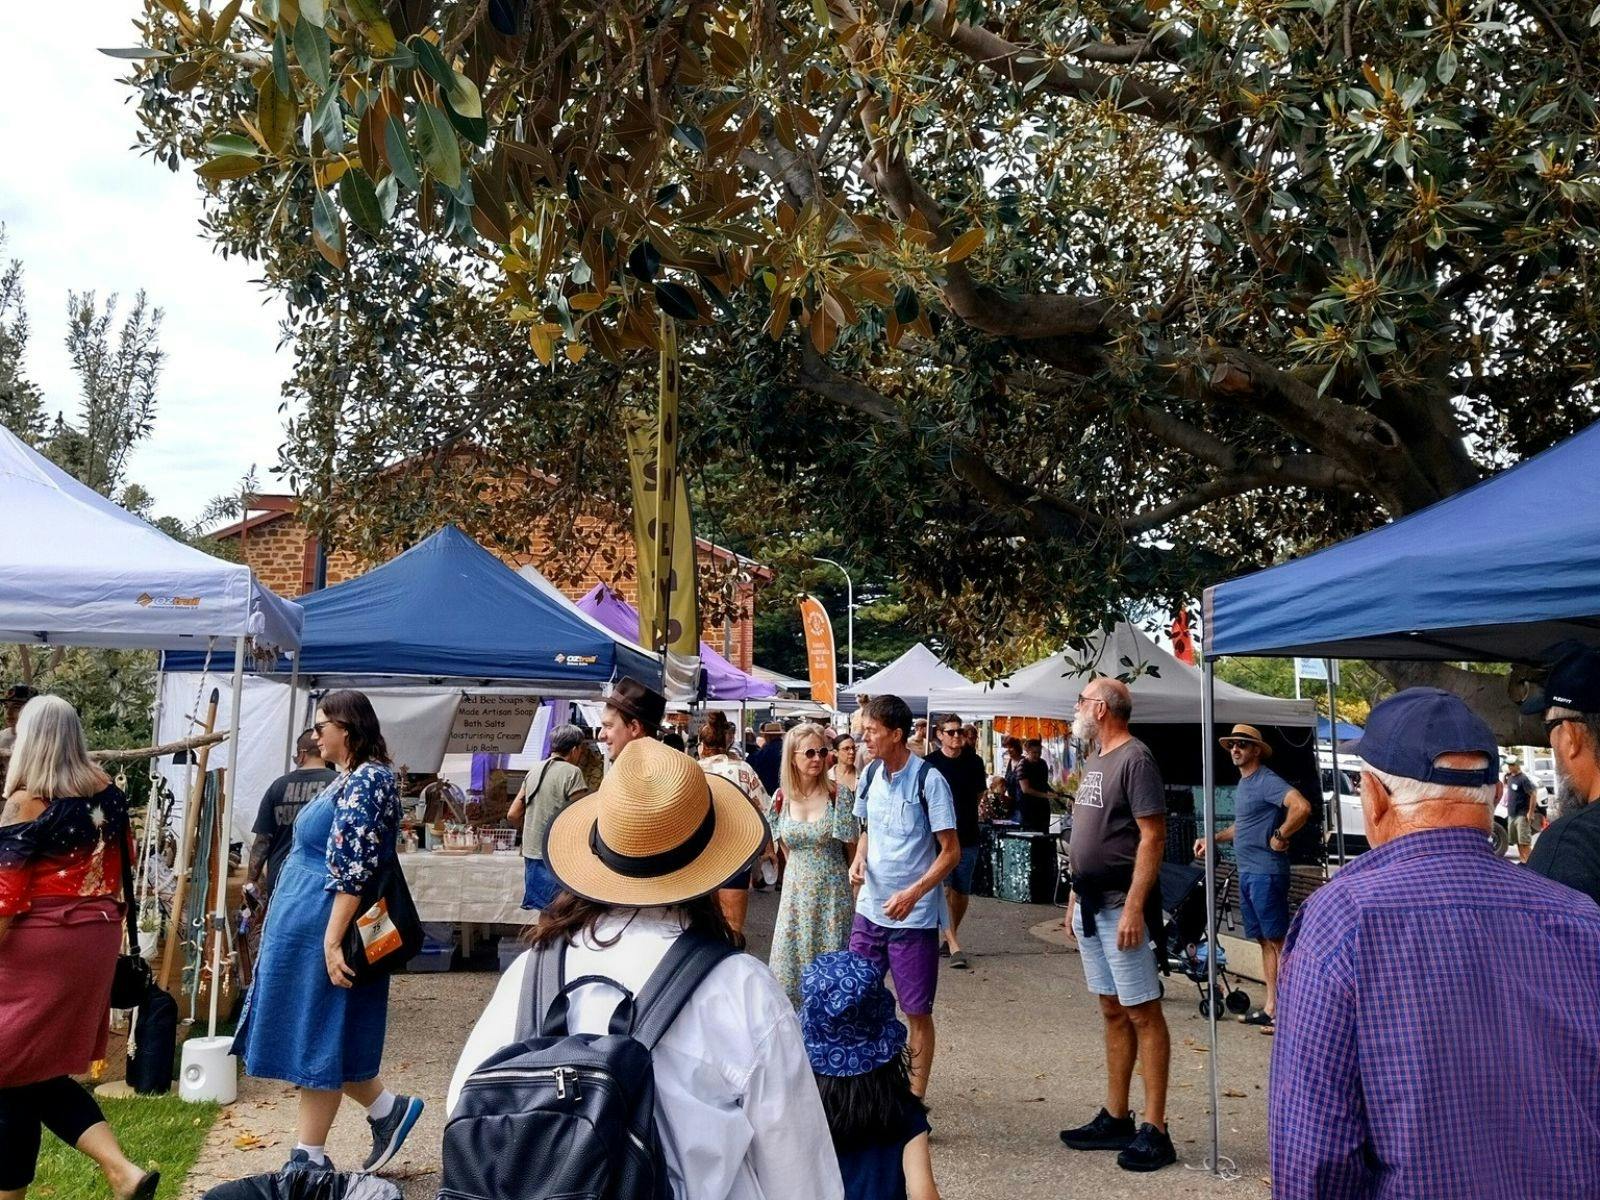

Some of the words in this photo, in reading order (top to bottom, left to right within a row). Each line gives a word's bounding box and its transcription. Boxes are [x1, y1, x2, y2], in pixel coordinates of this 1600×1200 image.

[480, 696, 495, 704] Bee
[499, 696, 524, 706] Soaps
[482, 707, 512, 716] Artisan
[514, 707, 533, 718] Soap
[464, 720, 482, 728] Bath
[485, 720, 505, 728] Salts
[497, 732, 521, 740] Cream
[466, 744, 478, 753] Lip
[481, 744, 499, 752] Balm
